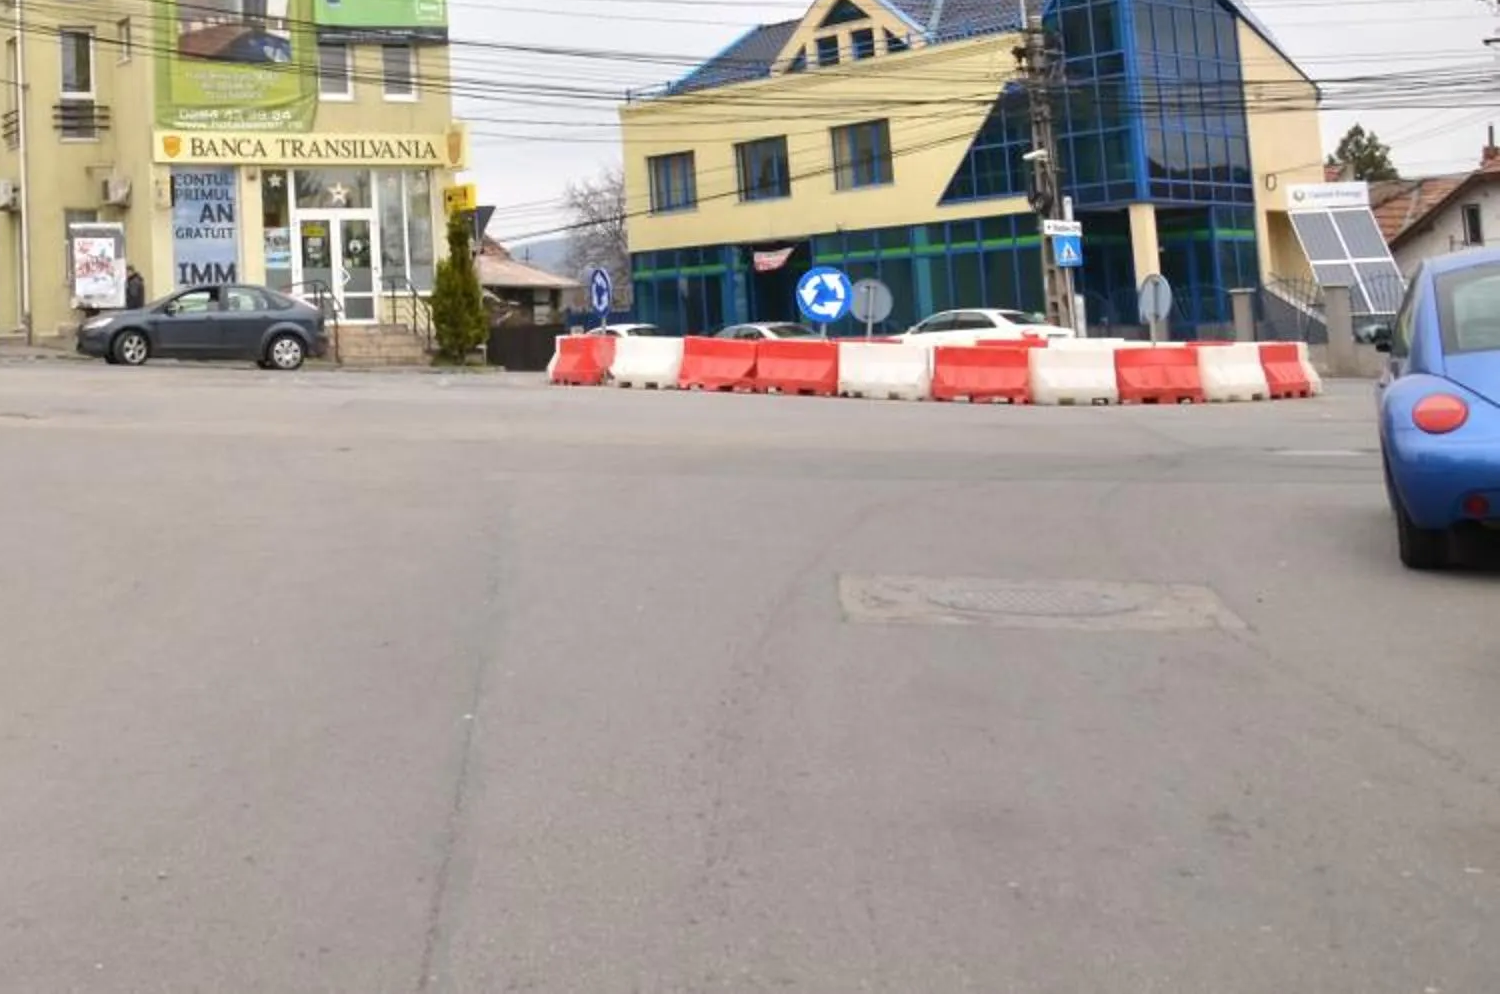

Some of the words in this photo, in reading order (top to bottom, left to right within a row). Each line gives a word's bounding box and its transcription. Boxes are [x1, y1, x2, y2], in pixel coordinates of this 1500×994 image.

[190, 137, 267, 158] BANCA
[275, 138, 437, 159] TRANSILVANIA
[176, 173, 232, 186] CONTUL
[176, 188, 233, 201] PRIMUL
[200, 203, 234, 223] AN
[175, 226, 236, 239] GRATUIT
[178, 262, 236, 285] IMM
